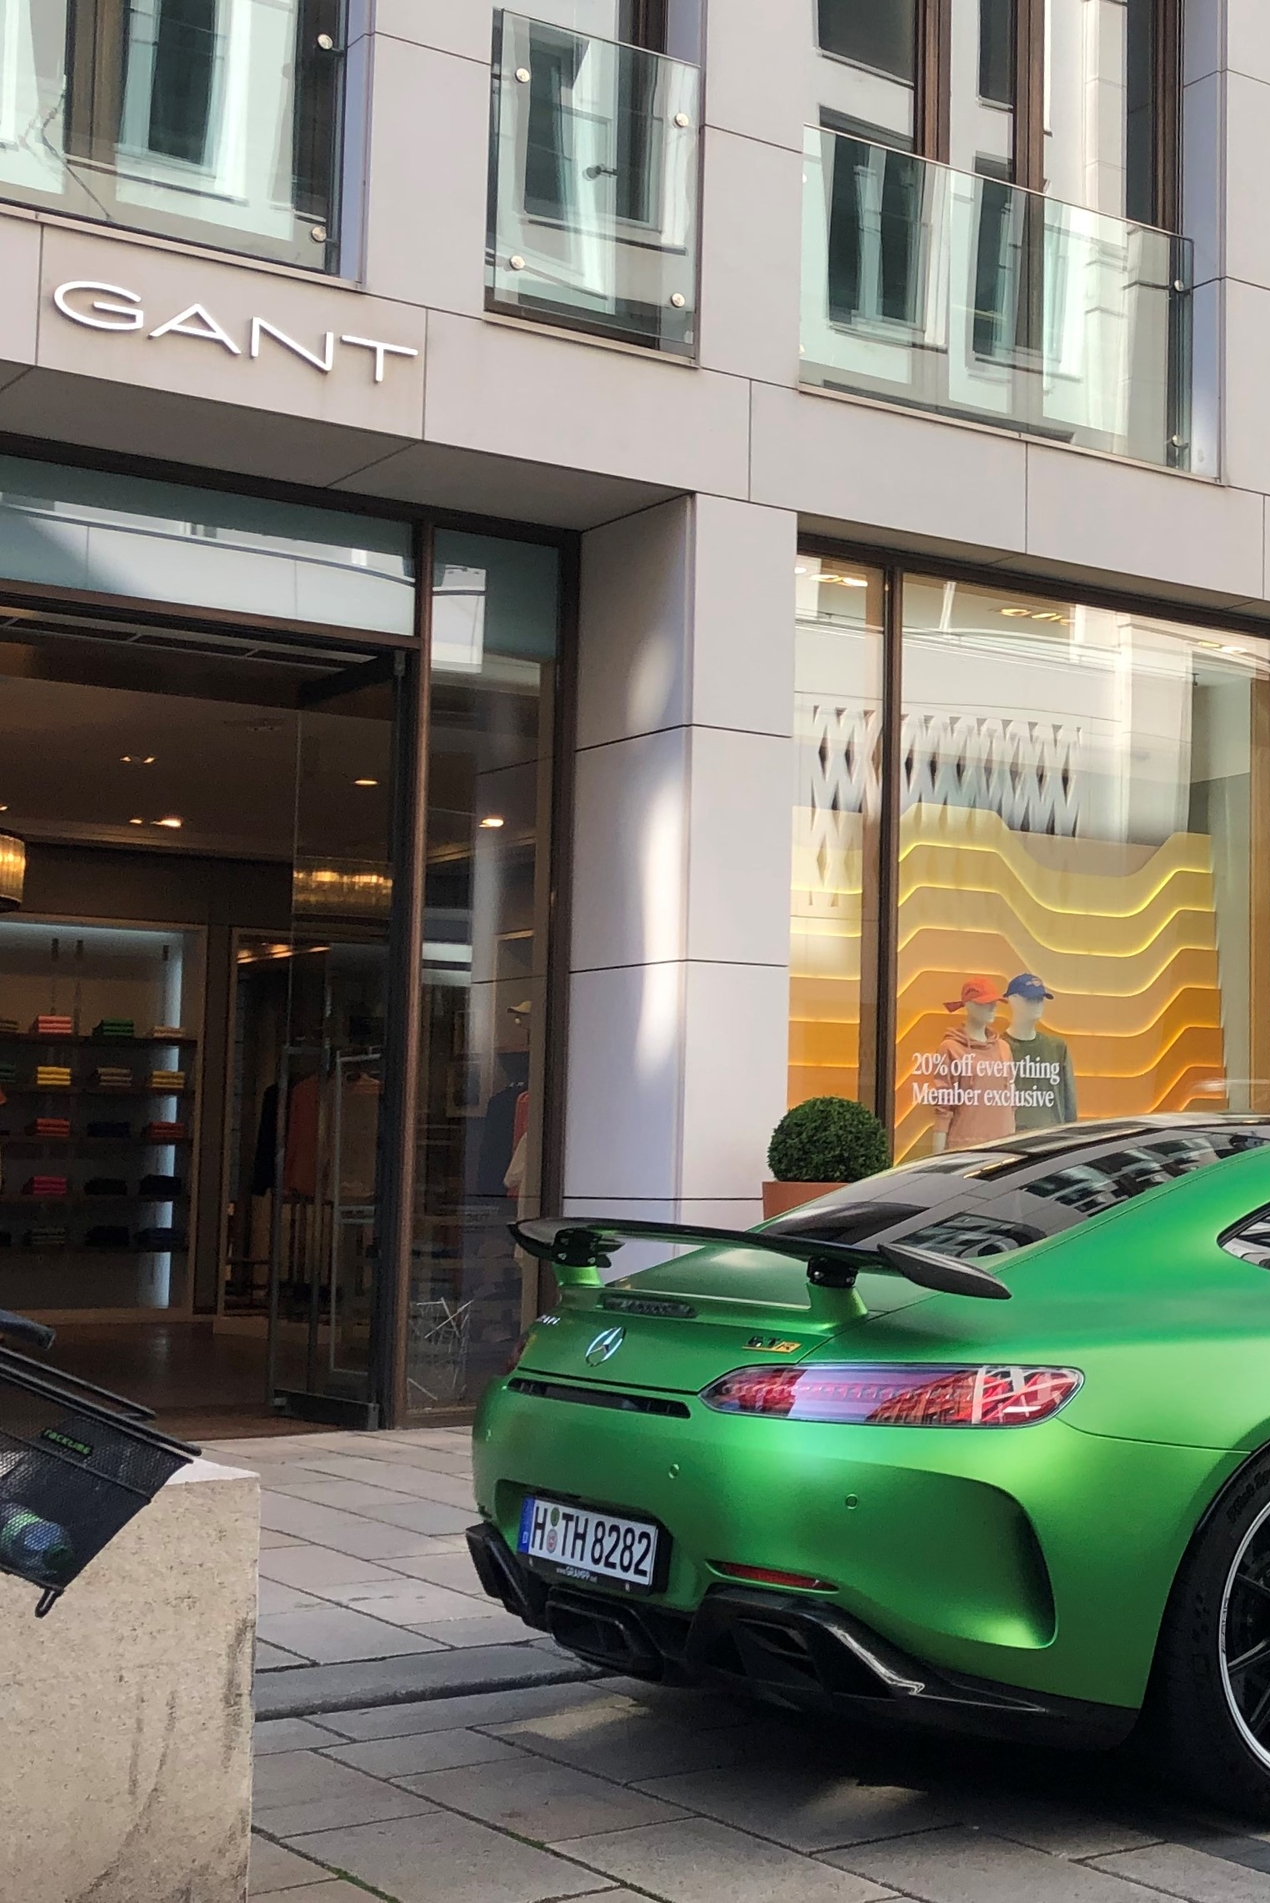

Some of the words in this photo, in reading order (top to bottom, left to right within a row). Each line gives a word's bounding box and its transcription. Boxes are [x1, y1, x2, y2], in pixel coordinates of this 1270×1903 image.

[54, 280, 418, 383] GANT
[911, 1052, 948, 1076] 20%
[951, 1053, 976, 1077] off
[976, 1054, 1061, 1085] everything
[911, 1082, 981, 1106] Member
[983, 1085, 1055, 1108] exclusive
[531, 1506, 548, 1550] H
[561, 1512, 589, 1562] TH
[591, 1520, 652, 1578] 8282
